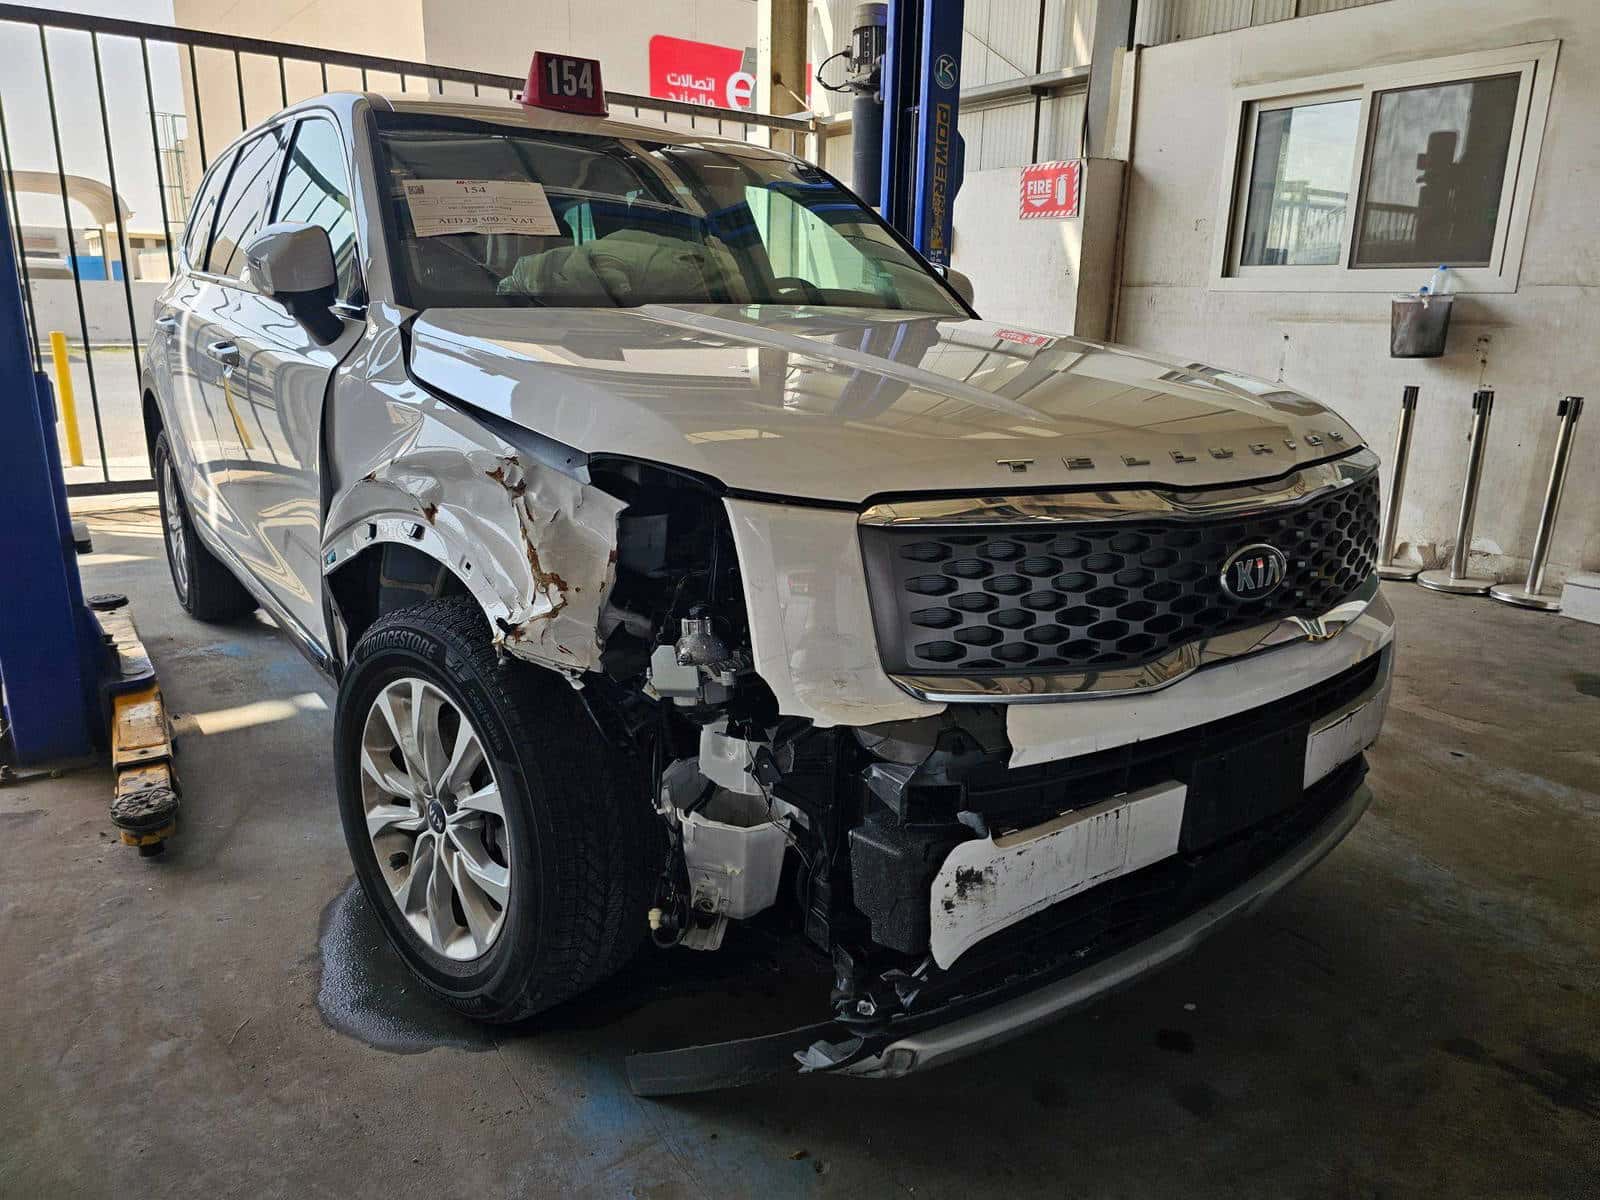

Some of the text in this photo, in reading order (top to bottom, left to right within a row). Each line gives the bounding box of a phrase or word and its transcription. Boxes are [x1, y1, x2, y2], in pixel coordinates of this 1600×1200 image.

[547, 58, 593, 98] 154
[666, 73, 715, 92] اتصالات
[464, 186, 487, 194] 154
[1027, 179, 1052, 195] FIRE
[511, 216, 537, 225] VAT
[996, 431, 1343, 472] TELLURIDE
[1235, 555, 1280, 592] KIA
[363, 630, 438, 660] BRIDGESTONE
